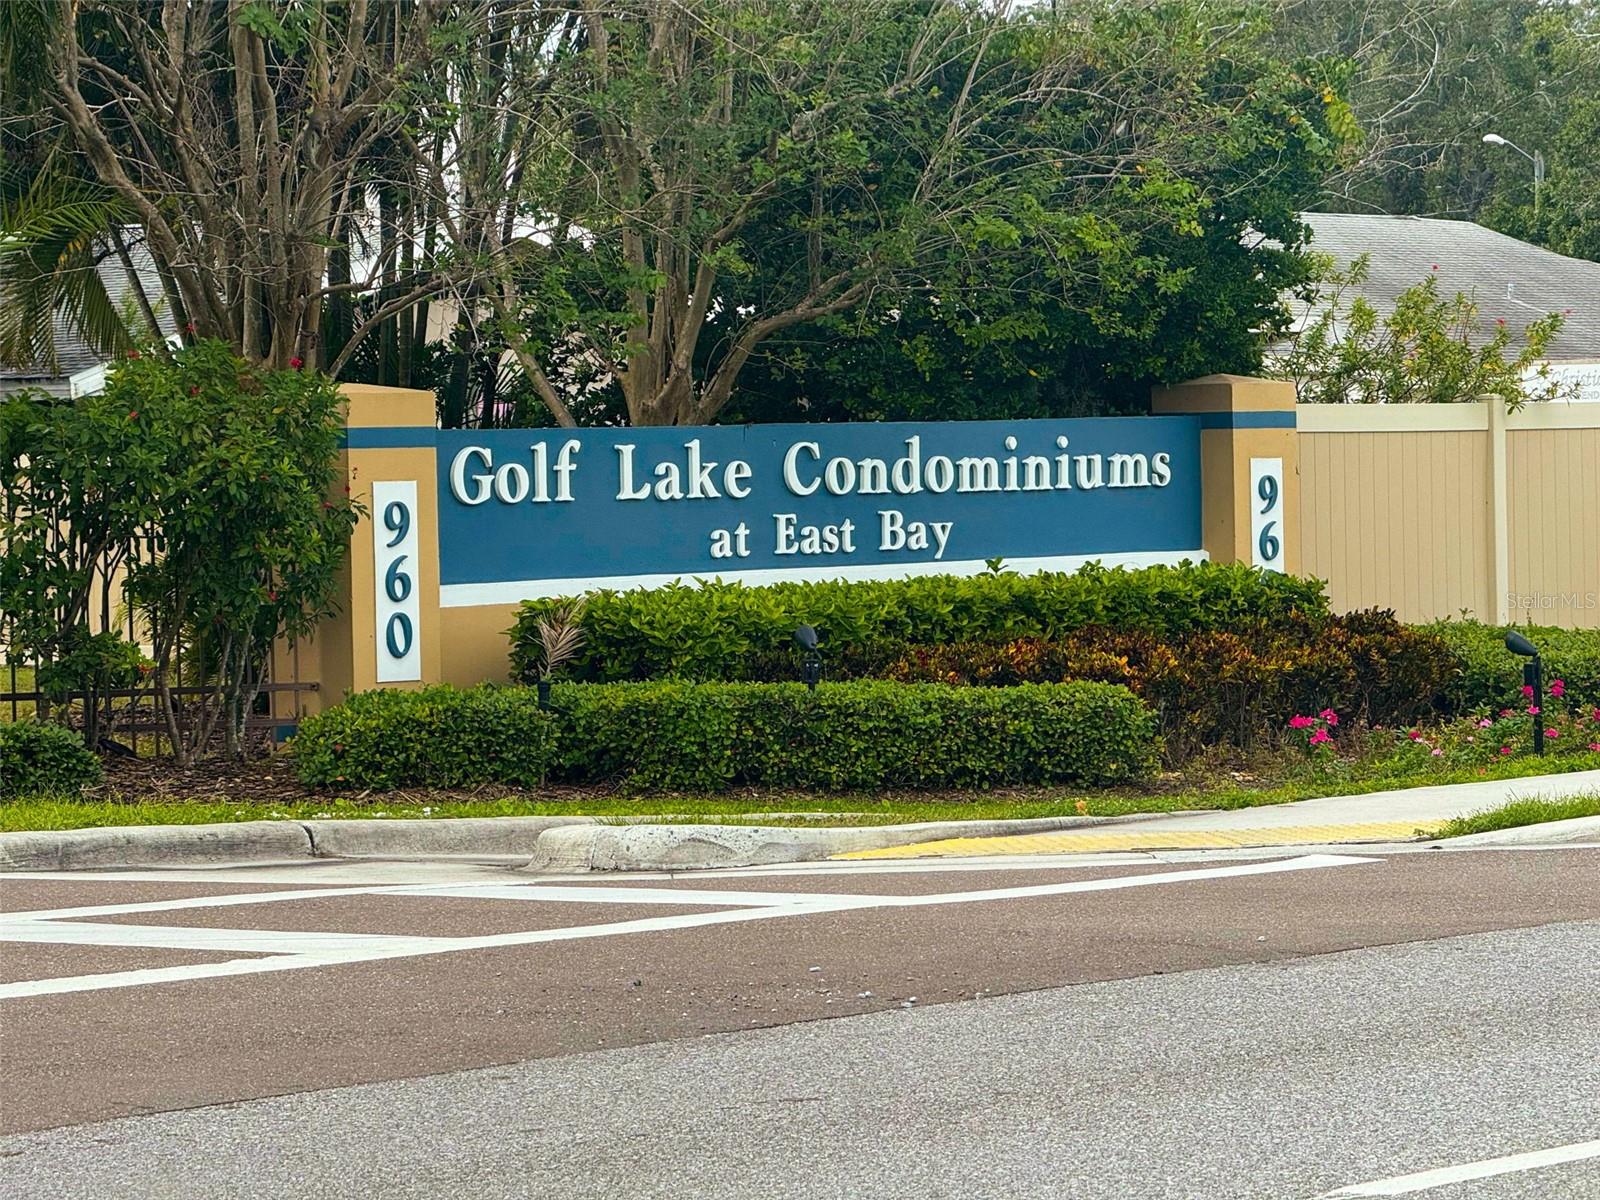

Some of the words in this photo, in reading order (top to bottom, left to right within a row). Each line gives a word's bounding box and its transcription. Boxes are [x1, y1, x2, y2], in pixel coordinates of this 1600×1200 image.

[450, 439, 581, 505] Golf
[614, 439, 752, 501] Lake
[784, 435, 1172, 495] Condominiums
[709, 522, 751, 559] at
[774, 513, 857, 554] East
[879, 509, 954, 559] Bay
[384, 501, 413, 658] 960
